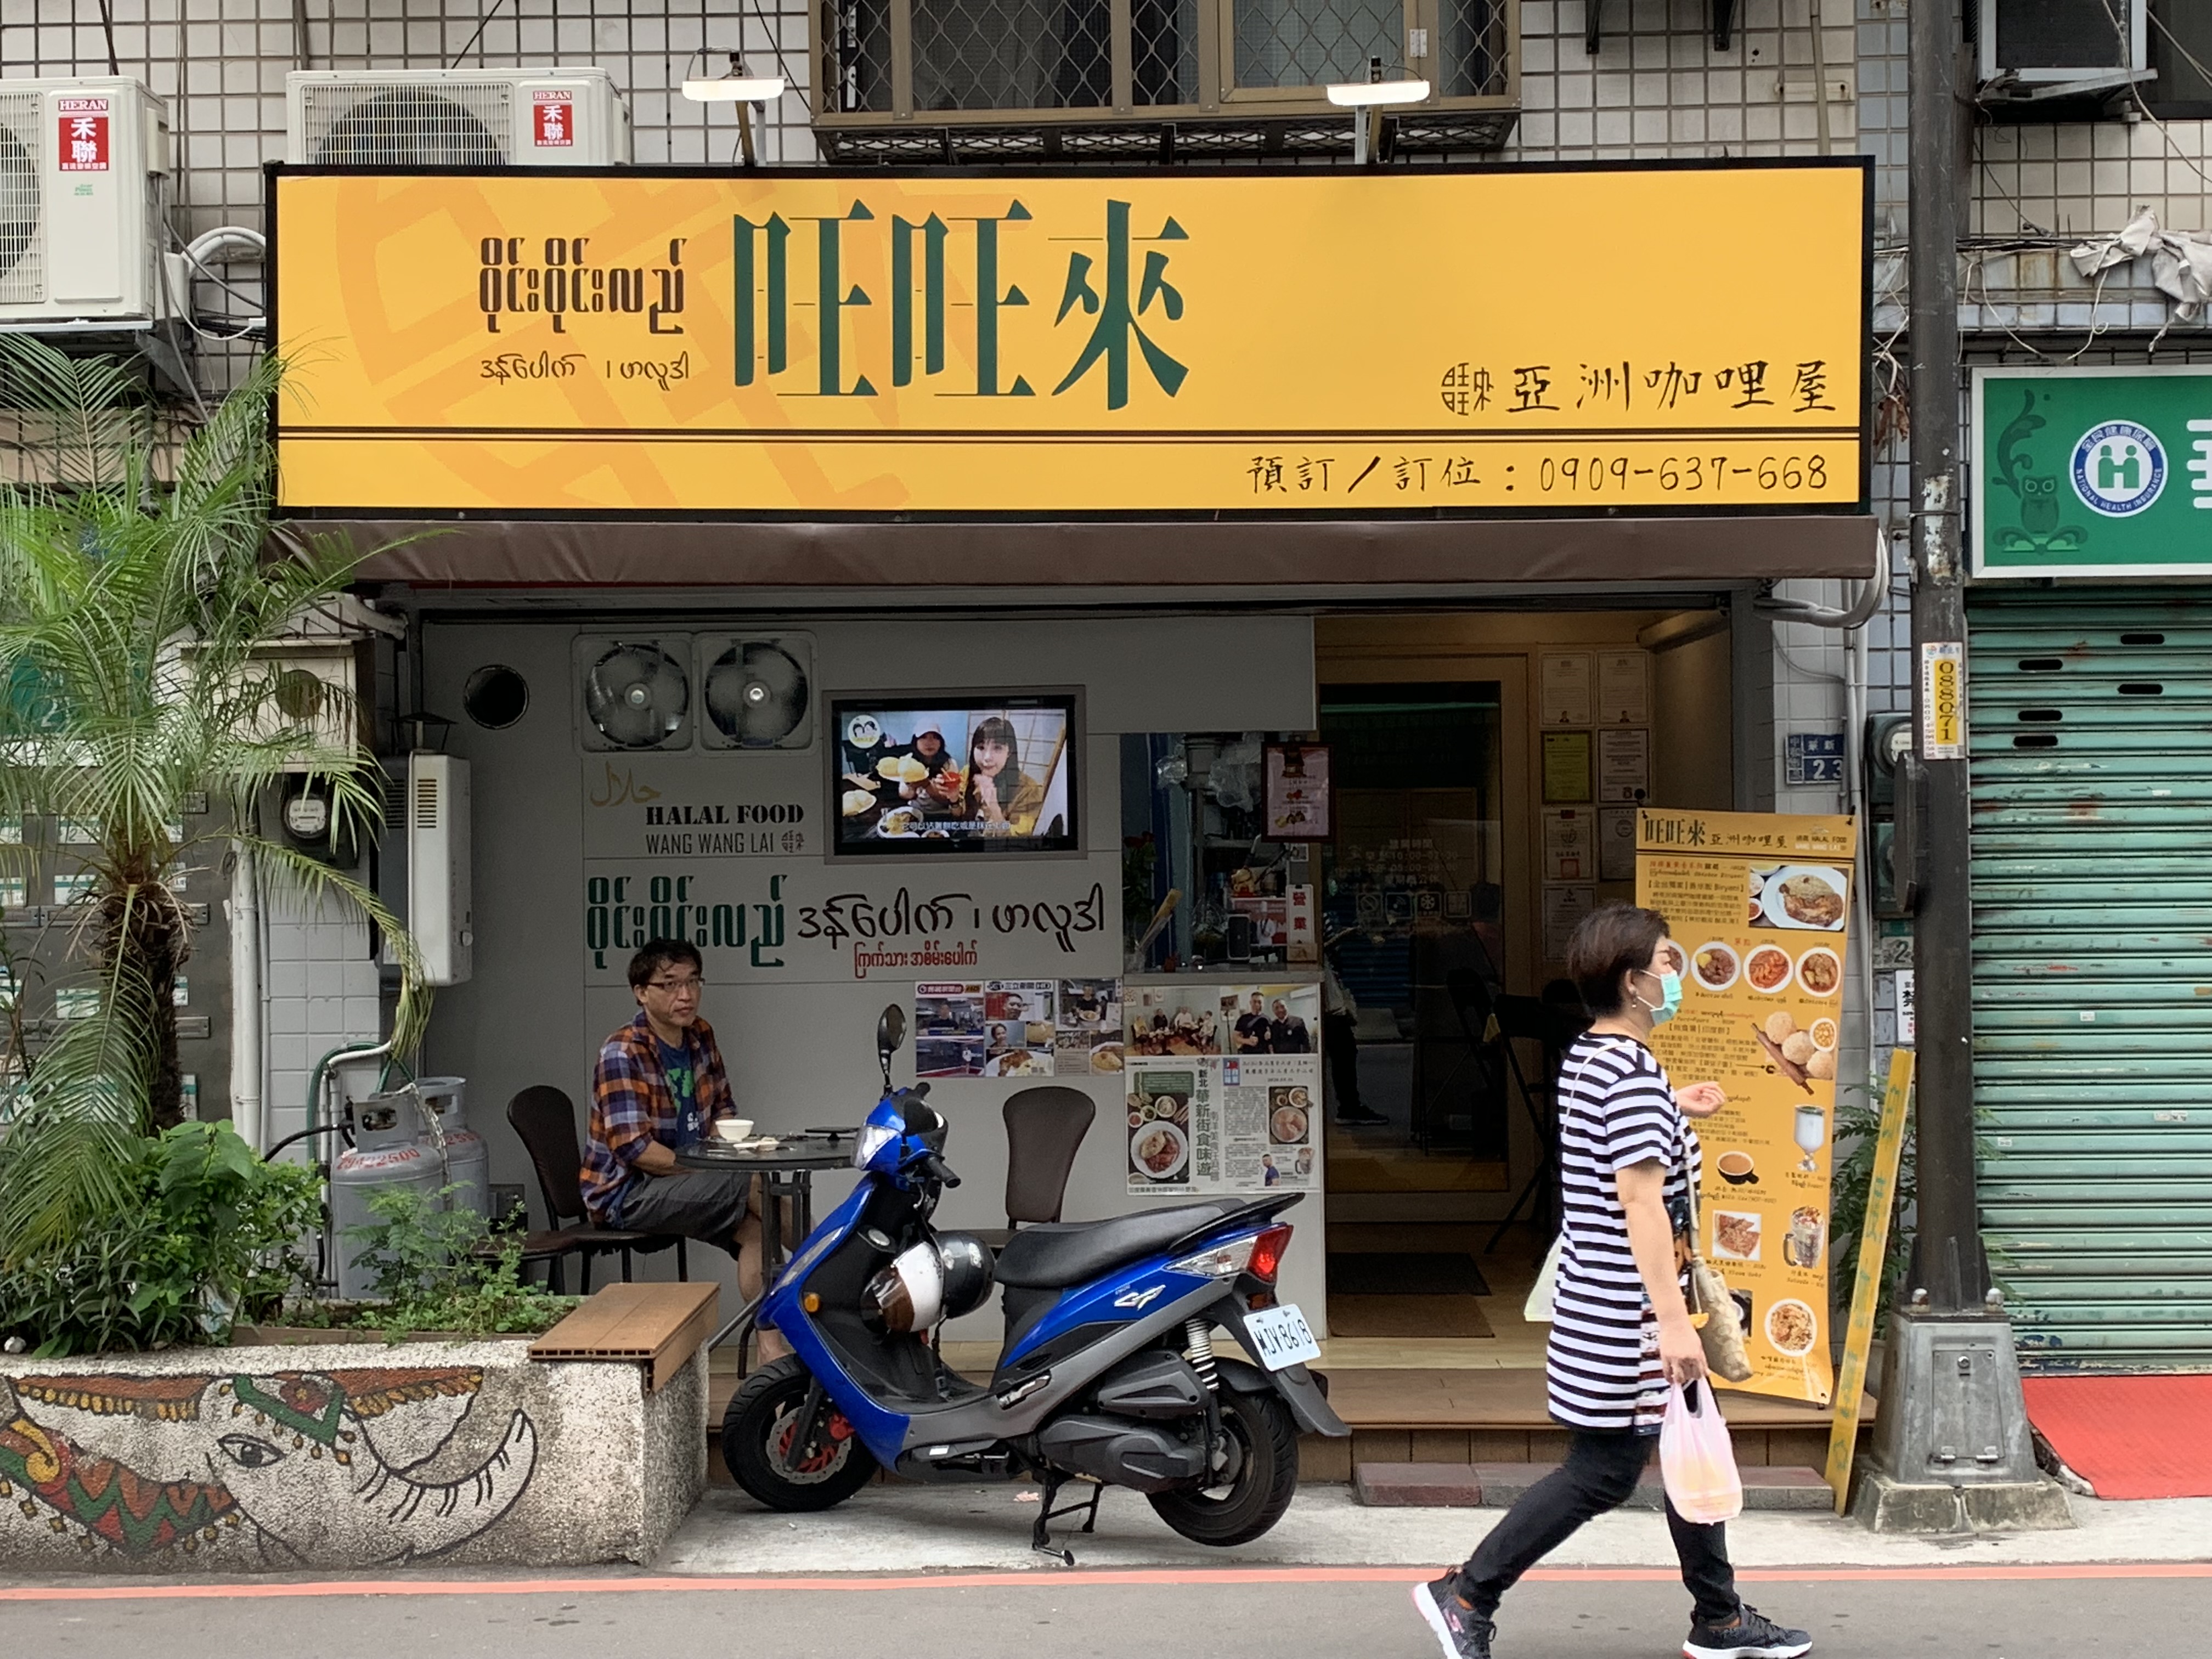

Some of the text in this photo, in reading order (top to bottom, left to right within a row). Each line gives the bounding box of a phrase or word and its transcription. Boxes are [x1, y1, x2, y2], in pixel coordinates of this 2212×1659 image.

[59, 100, 107, 110] HERAN
[534, 91, 571, 99] HERAN
[71, 117, 97, 163] 禾聯
[543, 105, 563, 140] 禾聯
[733, 198, 1189, 411] 旺旺來
[1505, 359, 1836, 414] 亞洲咖哩屋
[2076, 467, 2162, 511] NATIONAL HEALTH INSURANCE
[1939, 661, 1954, 741] 088071
[646, 804, 804, 825] HALAL FOOD
[1645, 817, 1706, 847] 旺旺來
[646, 833, 692, 855] WANG
[698, 833, 744, 854] WANG
[751, 832, 774, 853] LAI
[1195, 1069, 1211, 1176] 新北 華新街食味遊
